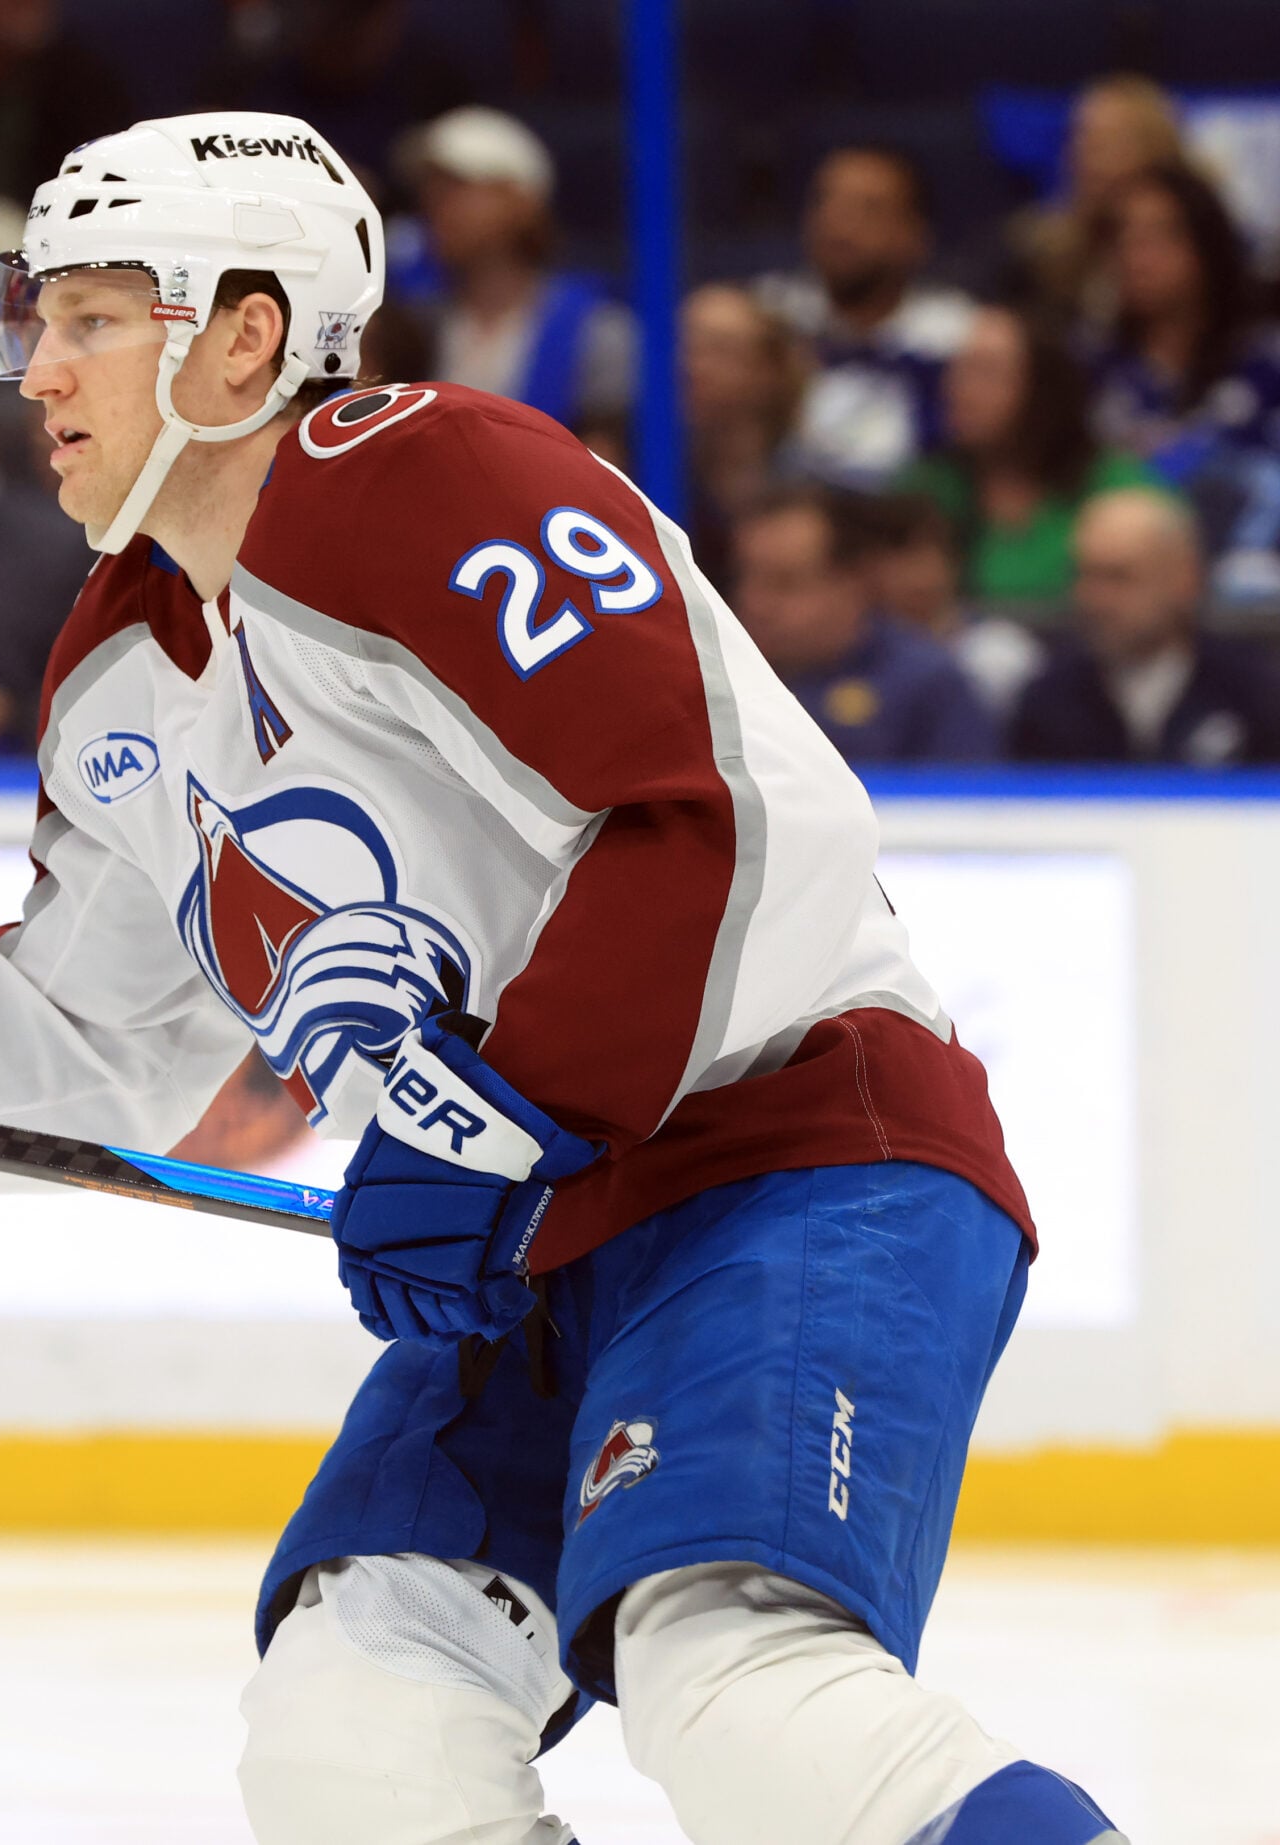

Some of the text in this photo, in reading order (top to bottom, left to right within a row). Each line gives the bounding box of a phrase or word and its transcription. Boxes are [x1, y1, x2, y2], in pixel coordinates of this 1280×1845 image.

[190, 133, 320, 165] Kiewit
[28, 204, 52, 220] CM
[153, 306, 195, 318] BAUER
[448, 506, 662, 682] 29
[232, 616, 294, 766] A
[84, 746, 144, 788] IMA
[512, 1185, 554, 1265] MACKINNON
[828, 1387, 856, 1522] CCM
